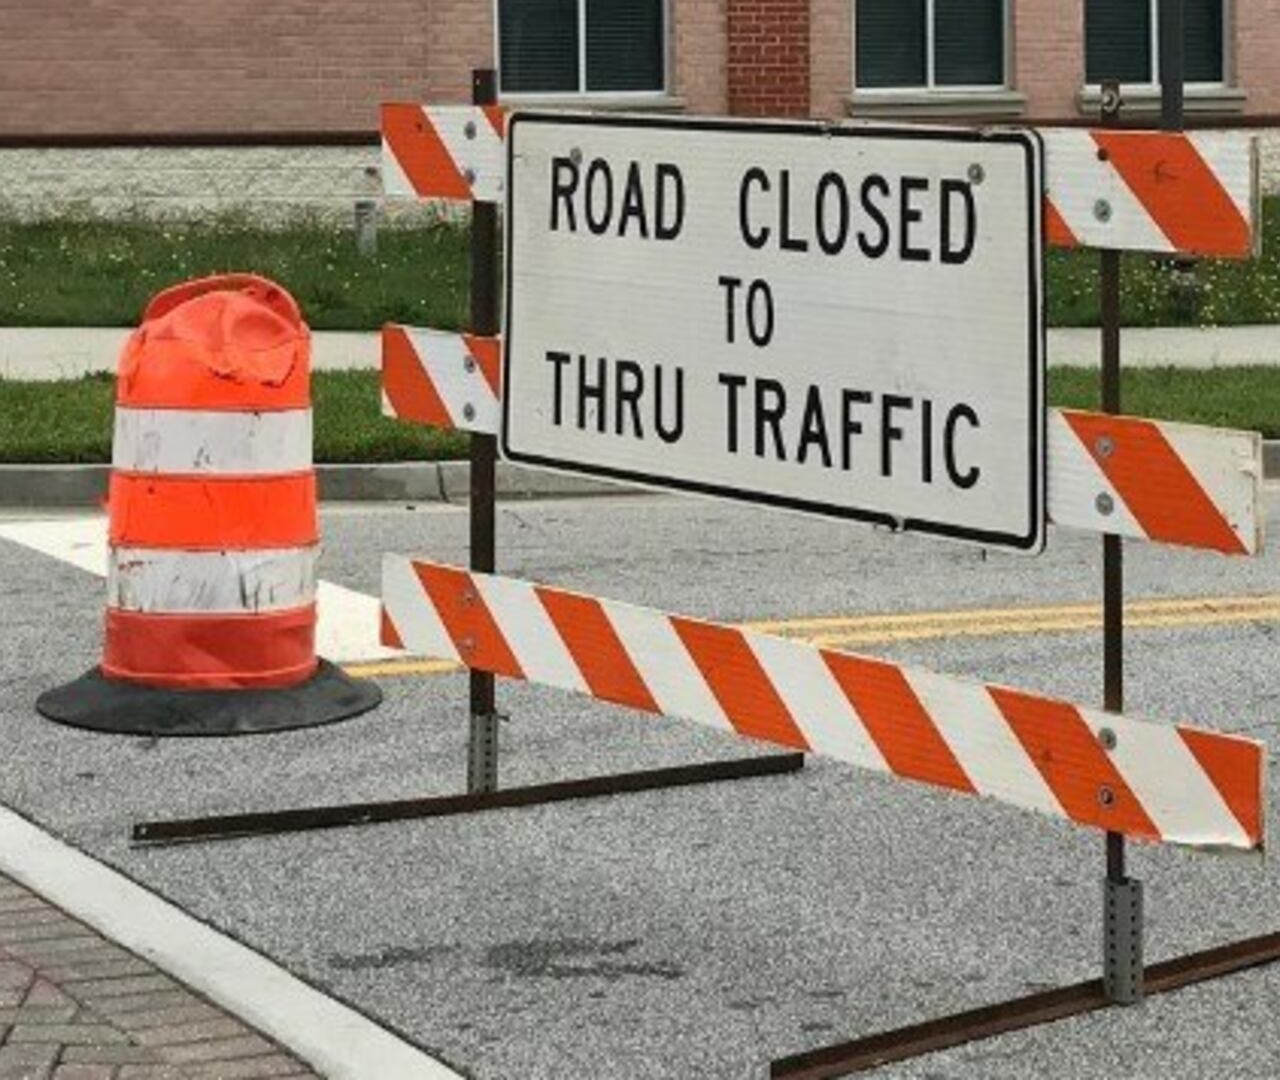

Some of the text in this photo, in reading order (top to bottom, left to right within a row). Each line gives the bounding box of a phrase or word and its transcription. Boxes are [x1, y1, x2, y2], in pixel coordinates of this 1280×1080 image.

[549, 156, 978, 265] ROAD CLOSED
[718, 275, 775, 347] TO
[546, 351, 981, 490] THRU TRAFFIC
